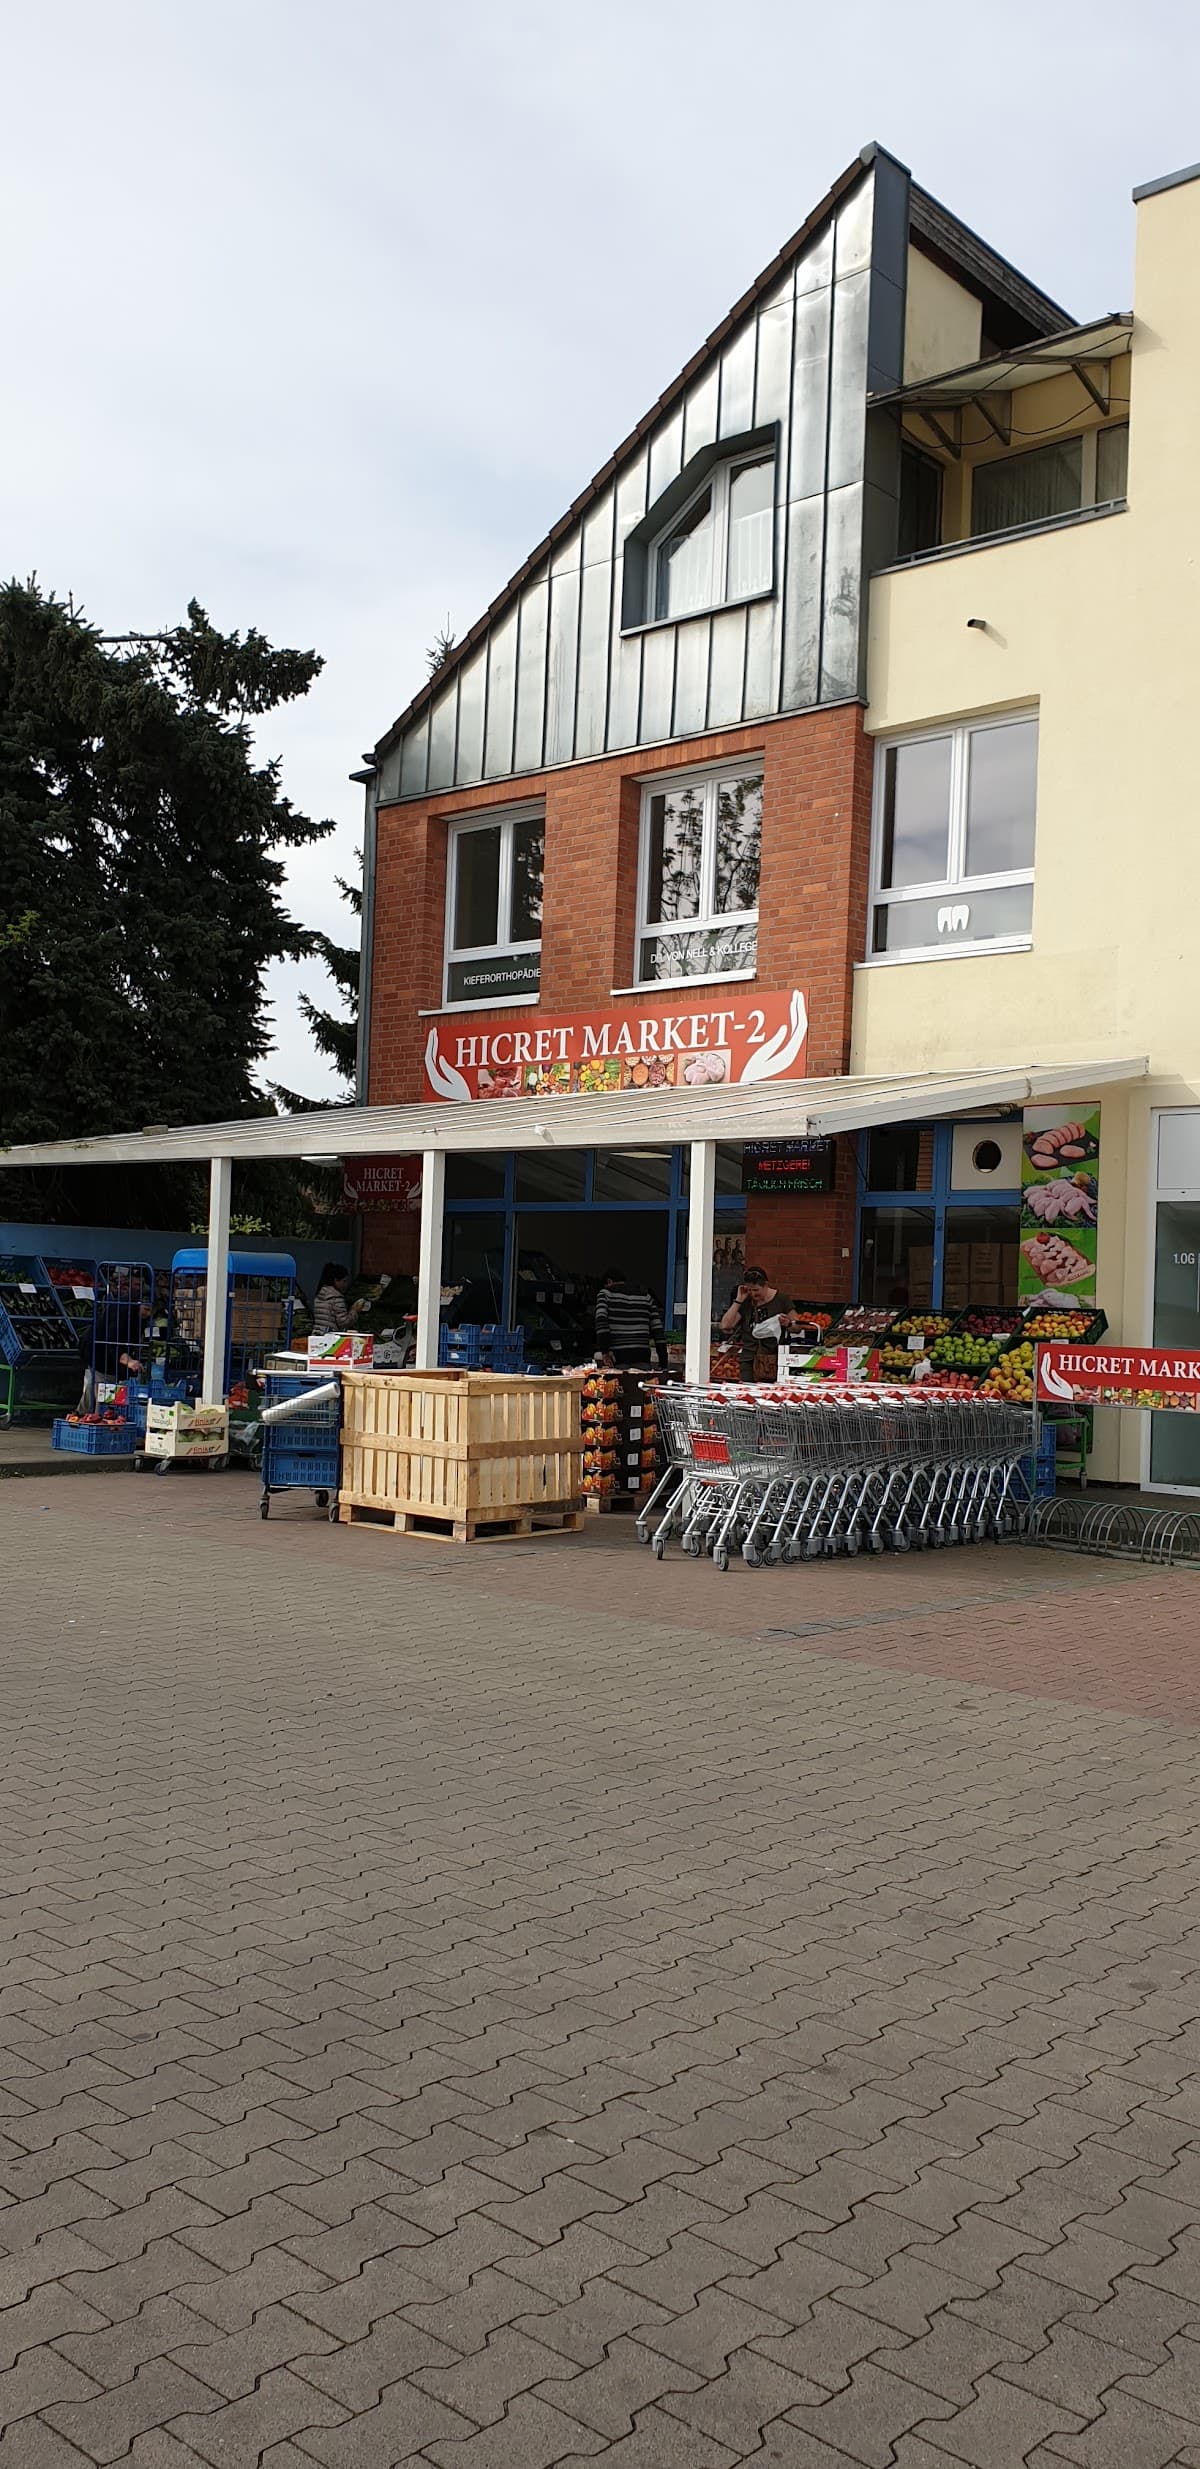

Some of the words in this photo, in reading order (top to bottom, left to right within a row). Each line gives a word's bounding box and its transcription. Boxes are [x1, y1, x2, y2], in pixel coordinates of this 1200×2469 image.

[666, 950, 686, 961] VON
[686, 947, 709, 959] NELL
[709, 946, 717, 956] &
[463, 967, 542, 986] KIEFERORTHOPÄDIE
[455, 1026, 574, 1068] HICRET
[580, 1009, 767, 1058] MARKET-2
[743, 1141, 784, 1153] HICRET
[363, 1167, 405, 1180] HICRET
[356, 1180, 411, 1192] MARKET-2
[1058, 1353, 1134, 1376] HICRET
[1138, 1358, 1200, 1380] MARK
